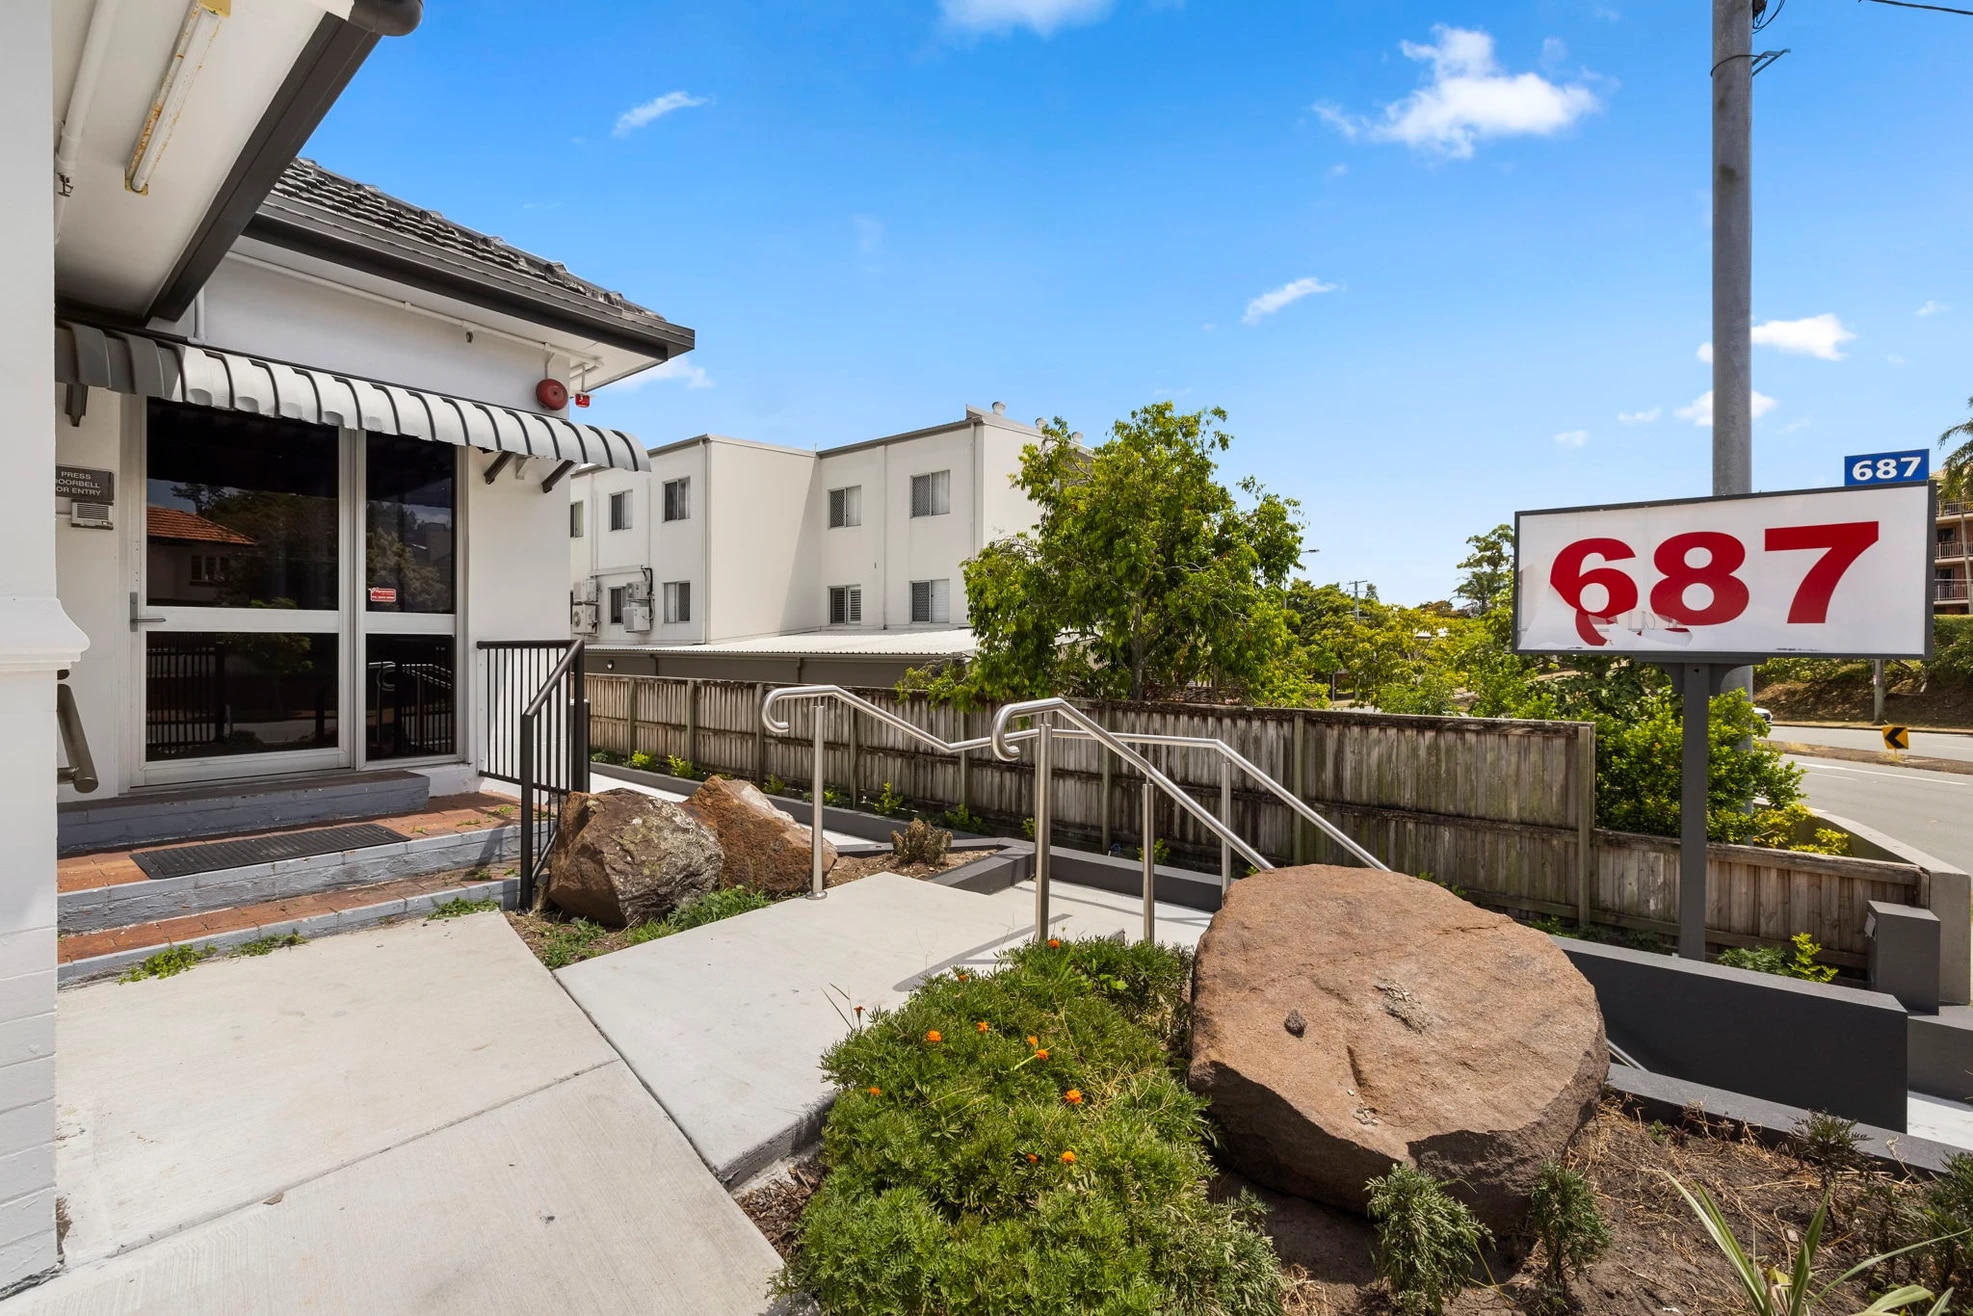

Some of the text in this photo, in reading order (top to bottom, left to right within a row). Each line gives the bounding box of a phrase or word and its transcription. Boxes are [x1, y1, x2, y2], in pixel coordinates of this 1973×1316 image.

[61, 471, 92, 480] PRESS
[1851, 456, 1922, 482] 687
[71, 488, 101, 496] ENTRY
[1550, 520, 1879, 642] 687
